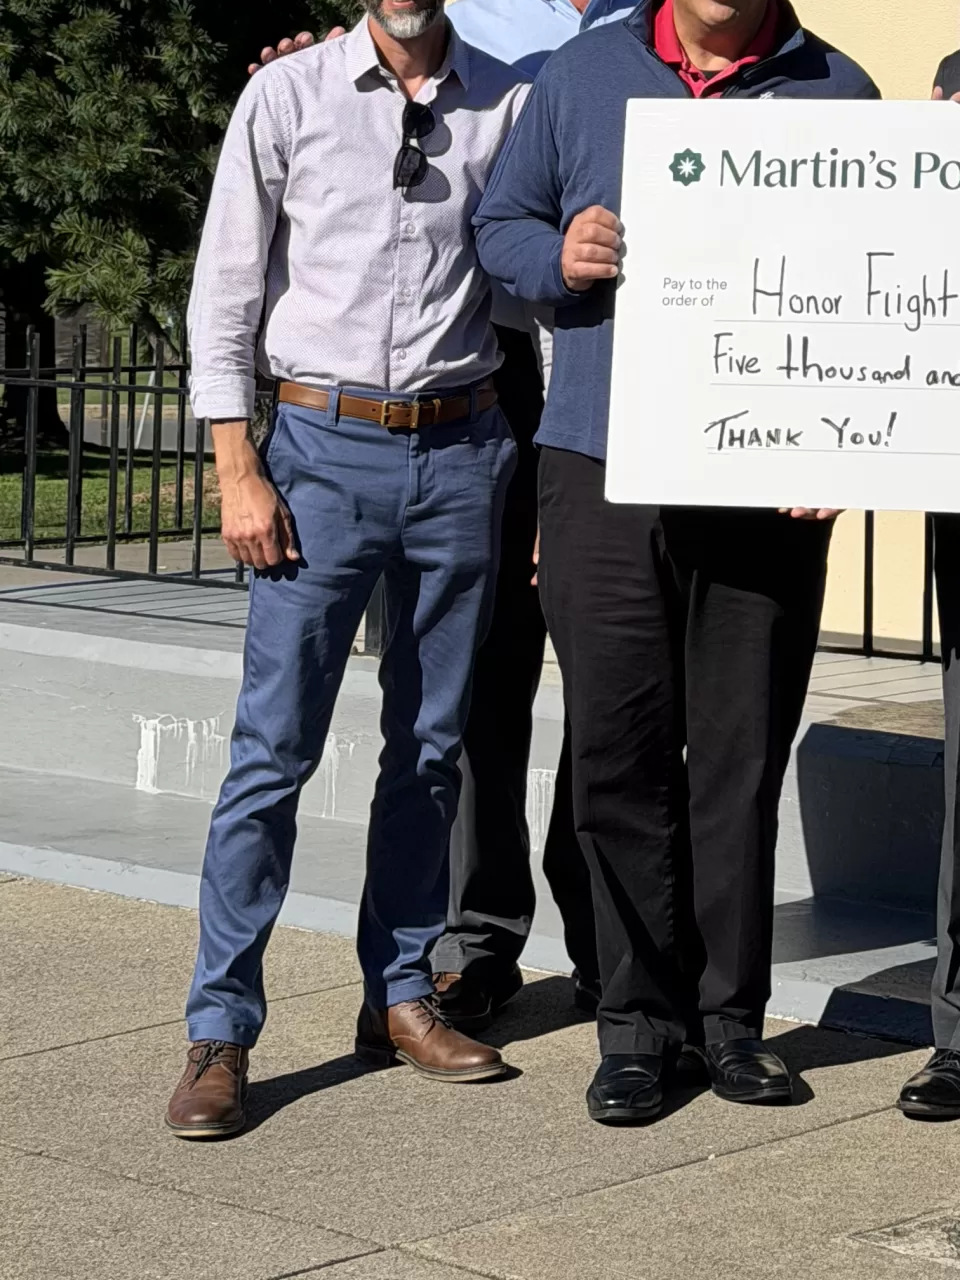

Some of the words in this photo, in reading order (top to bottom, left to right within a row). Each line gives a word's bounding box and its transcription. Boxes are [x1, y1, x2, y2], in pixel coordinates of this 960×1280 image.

[720, 148, 897, 189] Martin’s
[662, 295, 697, 306] order
[701, 295, 714, 306] of
[663, 278, 684, 291] Pay
[690, 279, 702, 289] to
[707, 279, 727, 290] the
[753, 255, 842, 317] Honor
[713, 332, 761, 375] Five
[776, 334, 910, 384] thousand
[704, 410, 804, 450] THANK
[821, 412, 897, 448] You!
